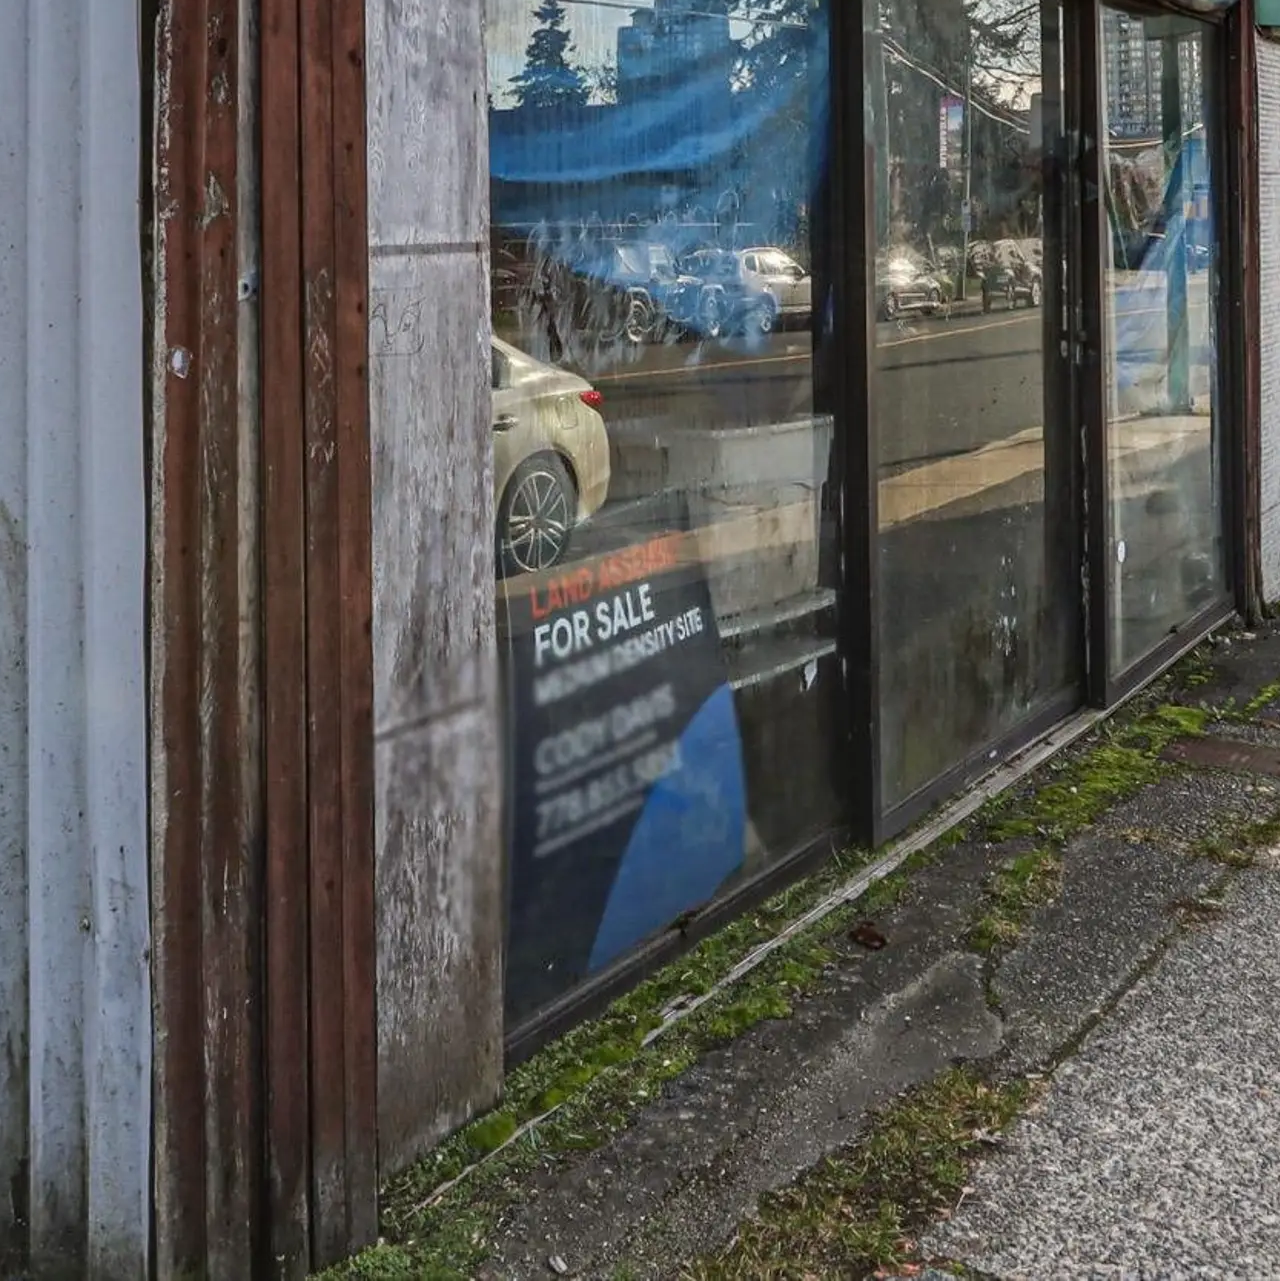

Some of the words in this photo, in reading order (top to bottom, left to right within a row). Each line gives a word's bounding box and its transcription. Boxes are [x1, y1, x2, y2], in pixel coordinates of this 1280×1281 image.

[529, 567, 593, 619] LAND
[534, 610, 592, 666] FOR
[595, 583, 655, 641] SALE
[676, 607, 703, 641] SITE
